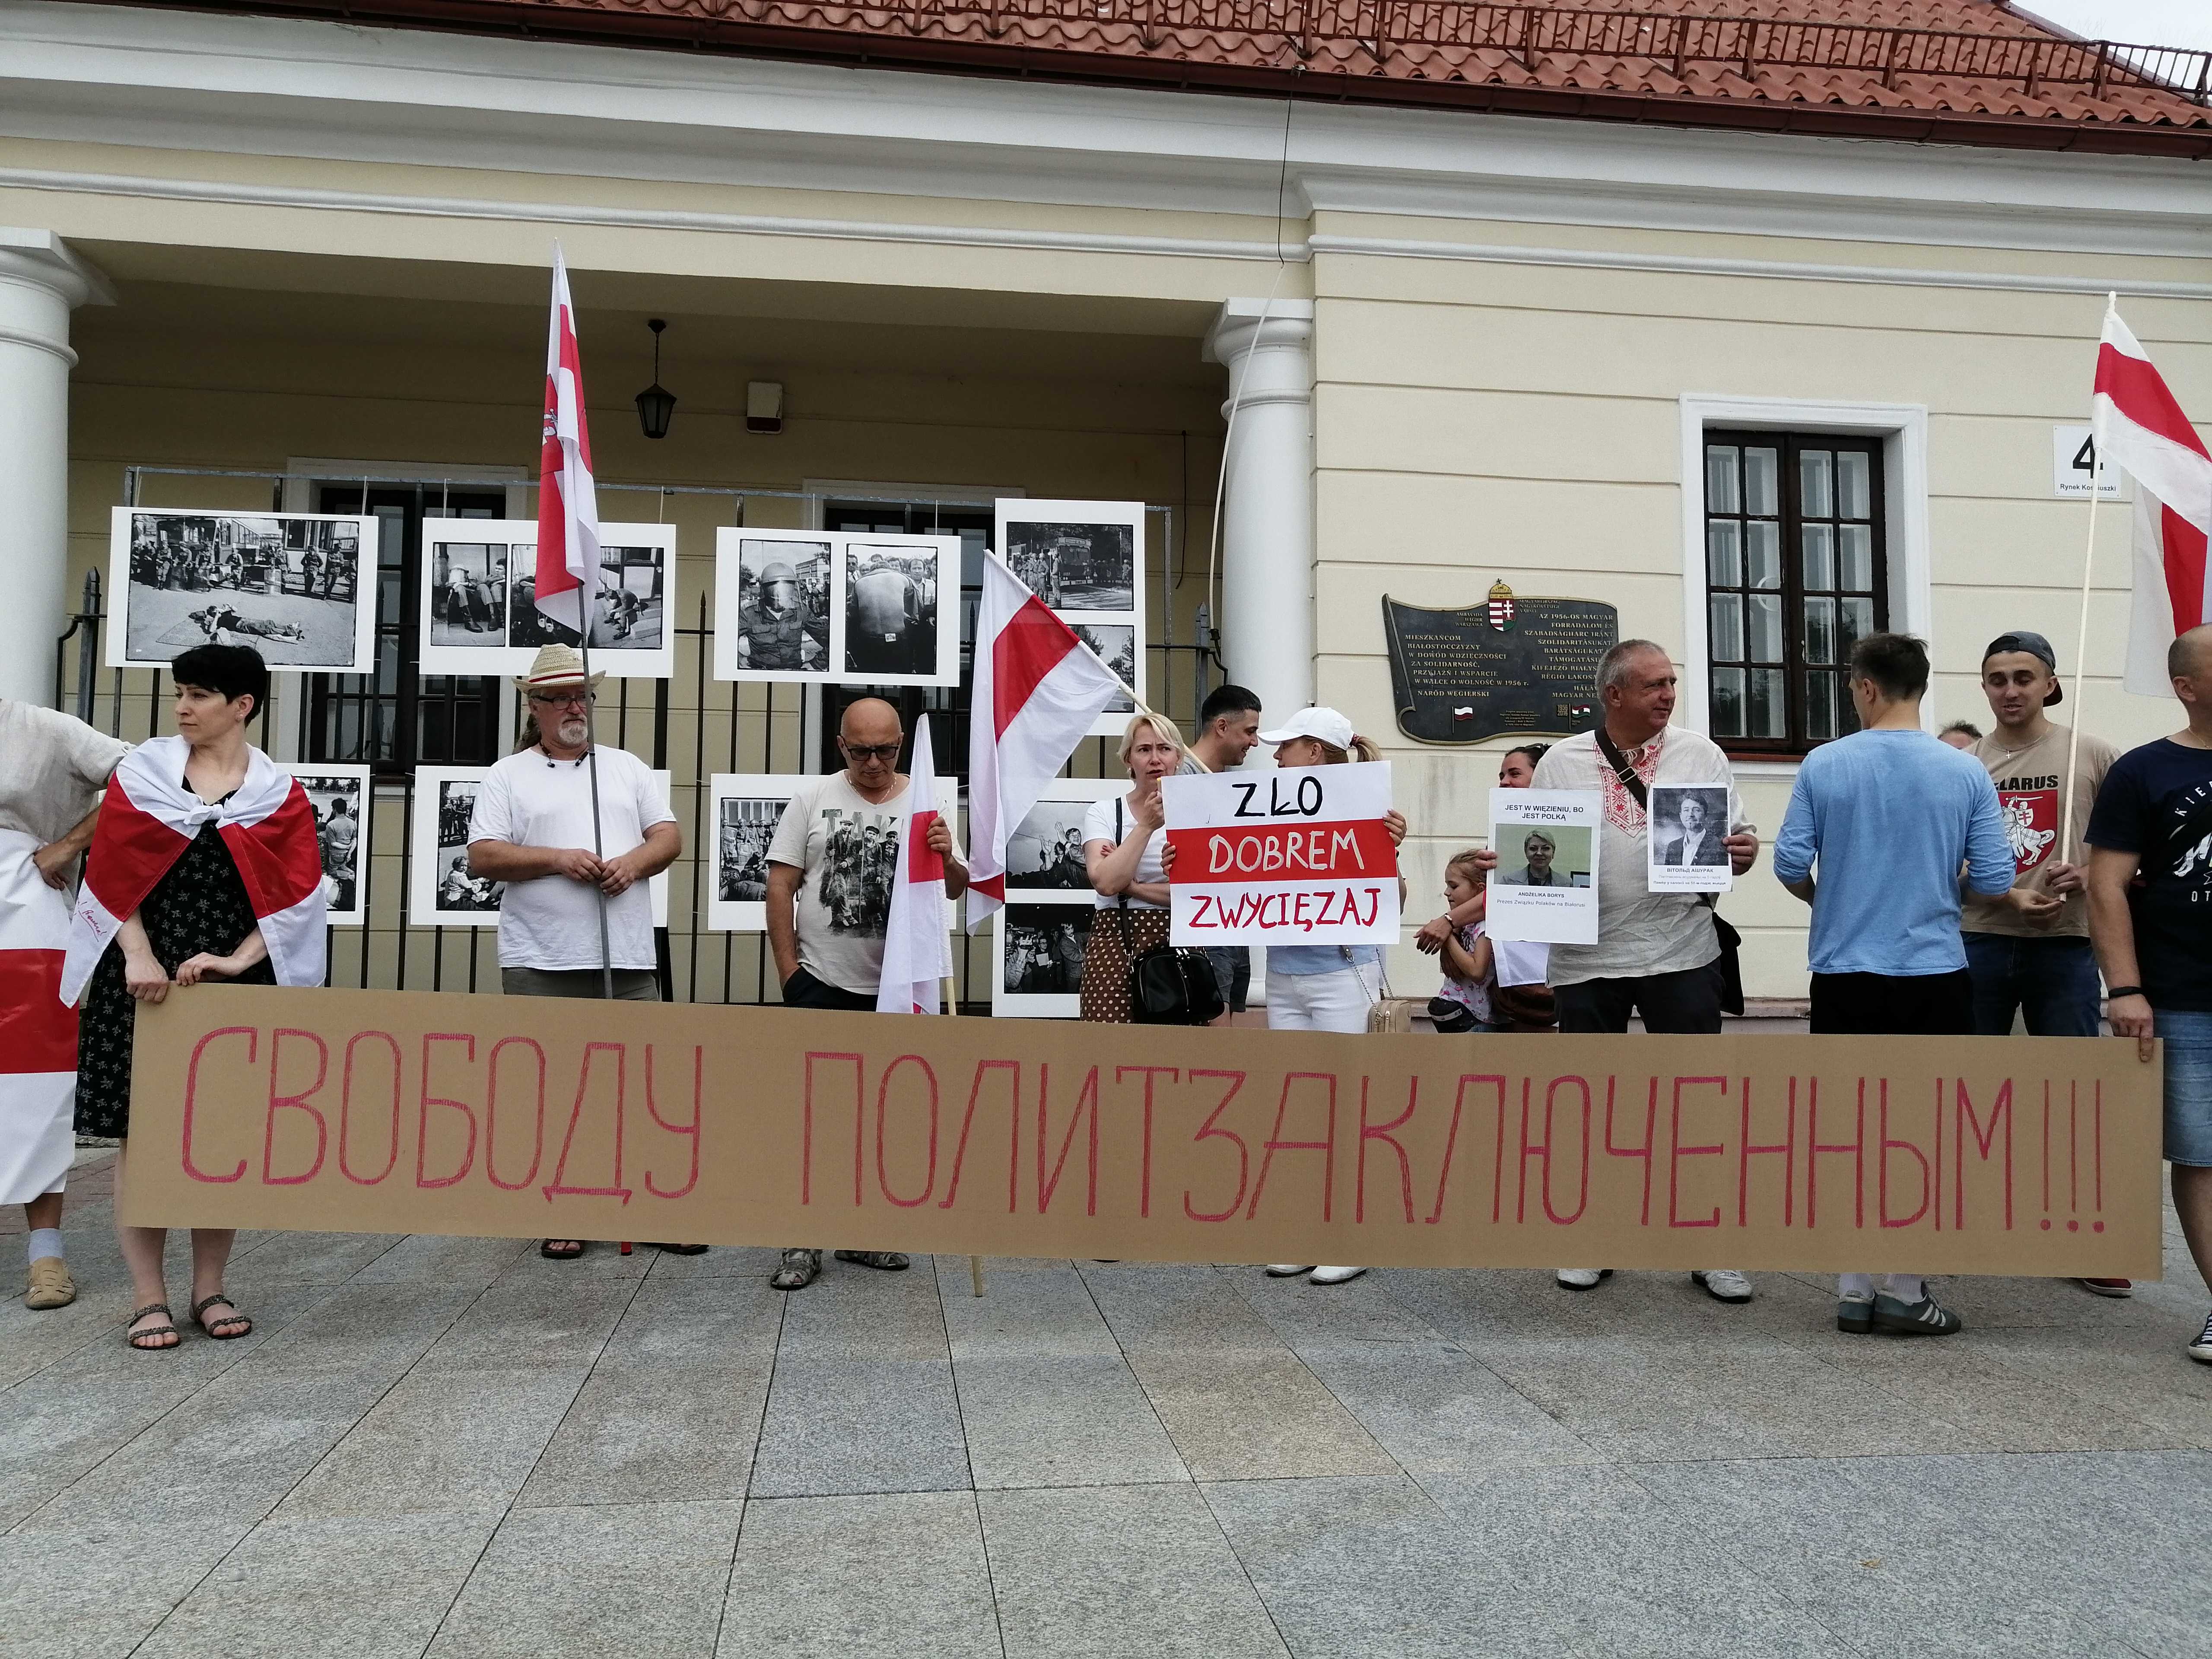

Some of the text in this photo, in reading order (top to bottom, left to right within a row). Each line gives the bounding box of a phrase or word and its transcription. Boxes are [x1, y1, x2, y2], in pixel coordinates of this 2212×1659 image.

[2072, 433, 2103, 479] 4
[1232, 776, 1323, 817] ZŁO
[1994, 775, 2058, 790] LARUS
[1209, 828, 1364, 873] DOBREM
[181, 1025, 2105, 1234] СВОБОДУ ПОЛИТЗАКЛЮЧЕННЫМ!!!
